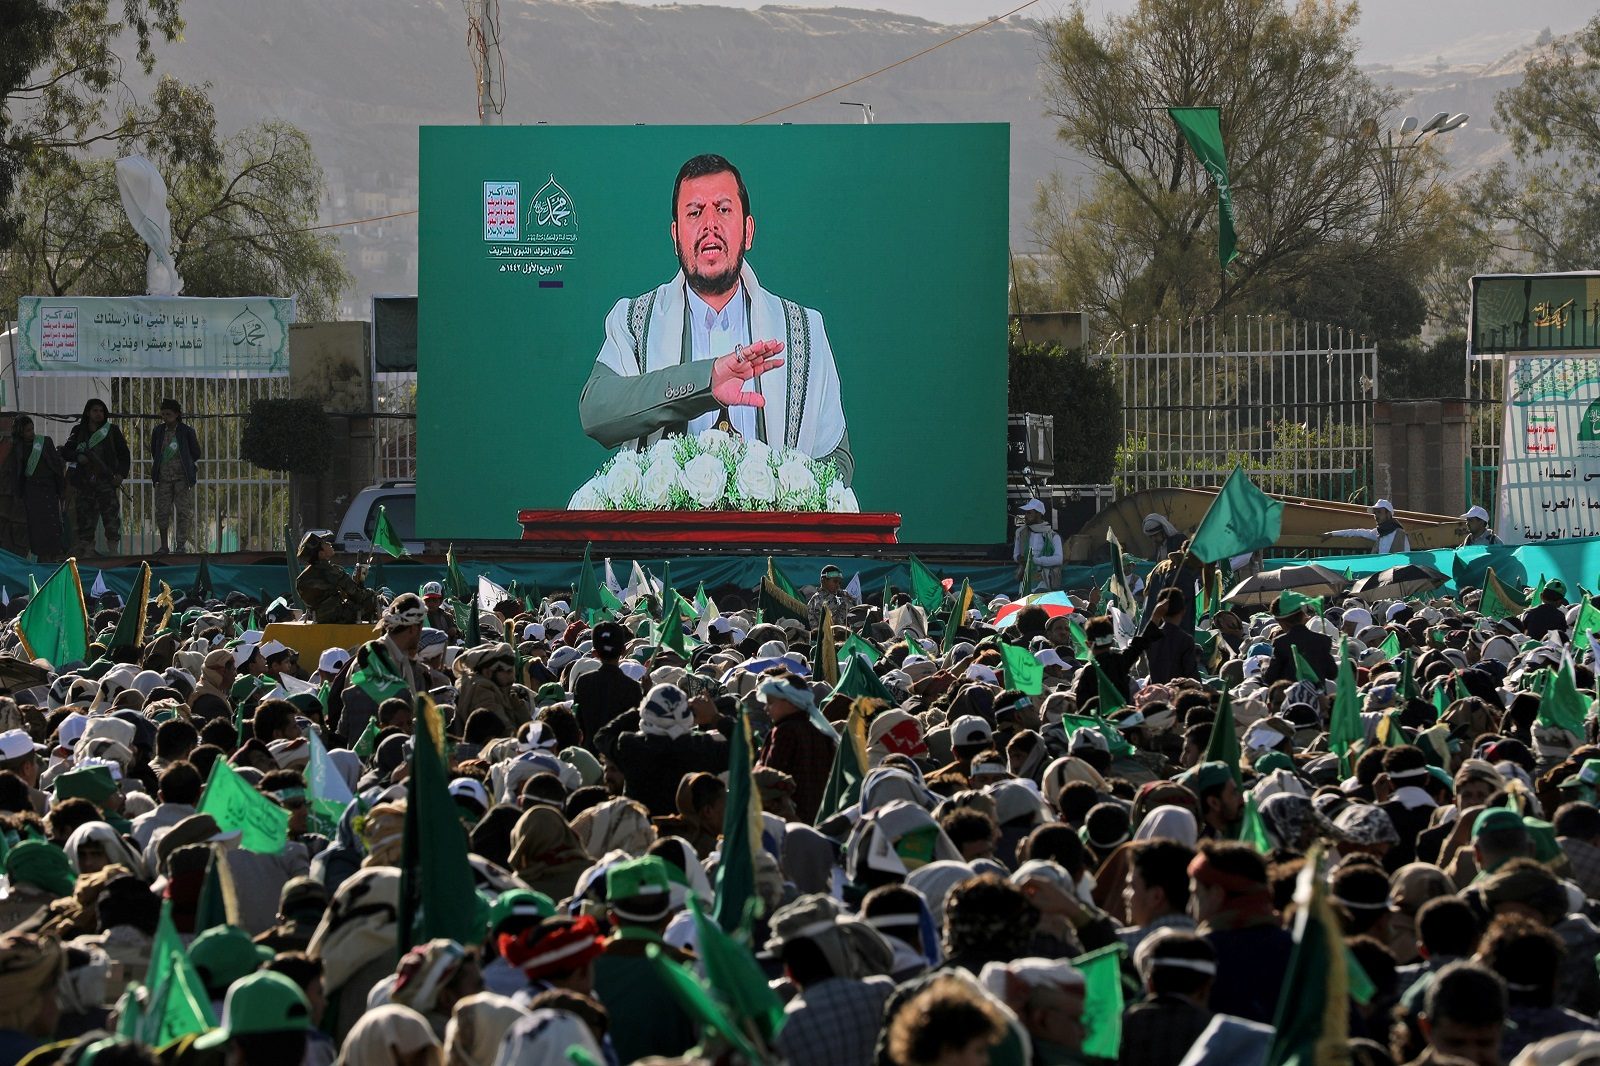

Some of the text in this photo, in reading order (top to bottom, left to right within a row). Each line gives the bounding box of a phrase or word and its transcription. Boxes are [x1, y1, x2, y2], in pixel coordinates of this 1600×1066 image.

[488, 246, 573, 256] ذكرى المولد النبوي الشريف
[539, 264, 554, 275] ربيع
[1539, 464, 1577, 478] أعداء
[1541, 497, 1575, 512] العرب
[1524, 526, 1566, 542] العربية
